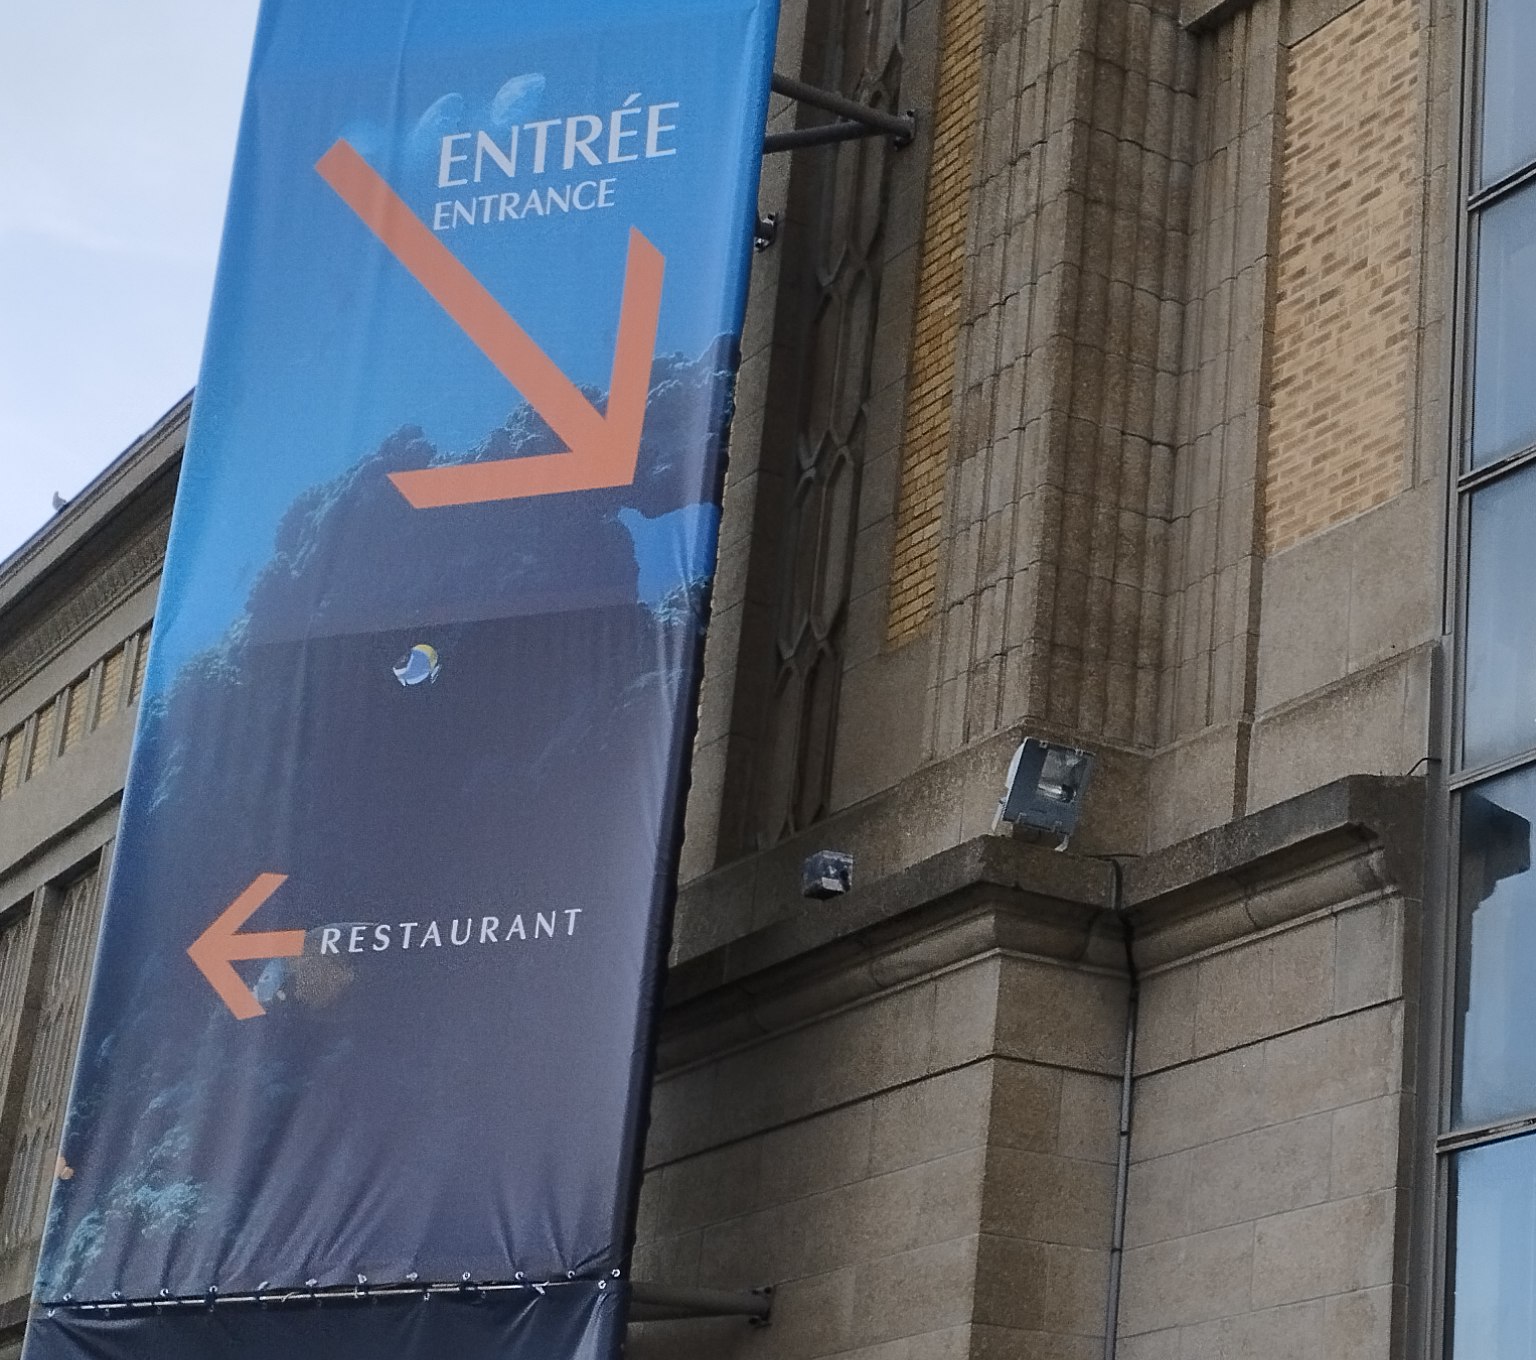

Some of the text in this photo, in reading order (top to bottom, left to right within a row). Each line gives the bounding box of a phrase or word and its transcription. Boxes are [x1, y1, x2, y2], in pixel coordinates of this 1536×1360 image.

[438, 92, 680, 188] ENTRÉE
[433, 178, 617, 231] ENTRANCE
[319, 908, 583, 956] RESTAURANT
